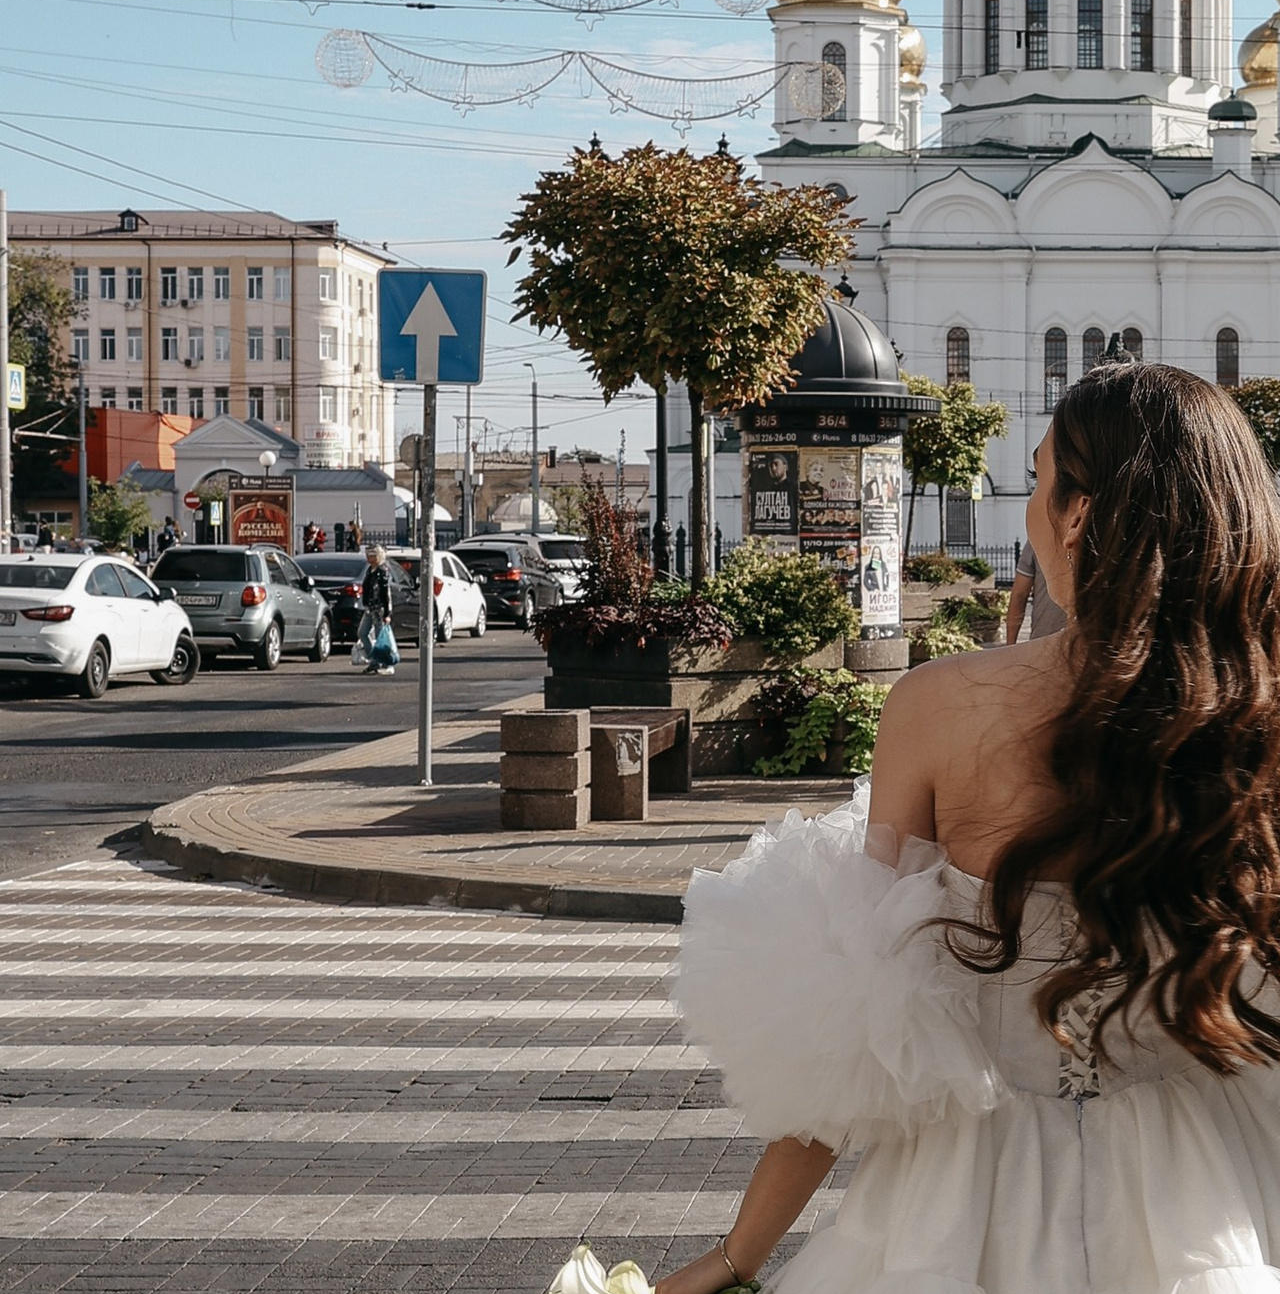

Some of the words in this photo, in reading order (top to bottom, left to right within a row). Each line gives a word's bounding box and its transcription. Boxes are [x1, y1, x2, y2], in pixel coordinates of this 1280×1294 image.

[755, 416, 777, 427] 36/5
[818, 415, 846, 427] 36/4
[880, 417, 898, 427] 36/3
[761, 432, 797, 443] 226-26-00
[822, 434, 841, 442] Russ
[850, 434, 857, 443] 8
[858, 433, 876, 444] (863)
[755, 491, 788, 506] СУЛТАН
[754, 505, 791, 520] ЛАГУЧЕВ
[869, 593, 897, 605] ИГОРЬ
